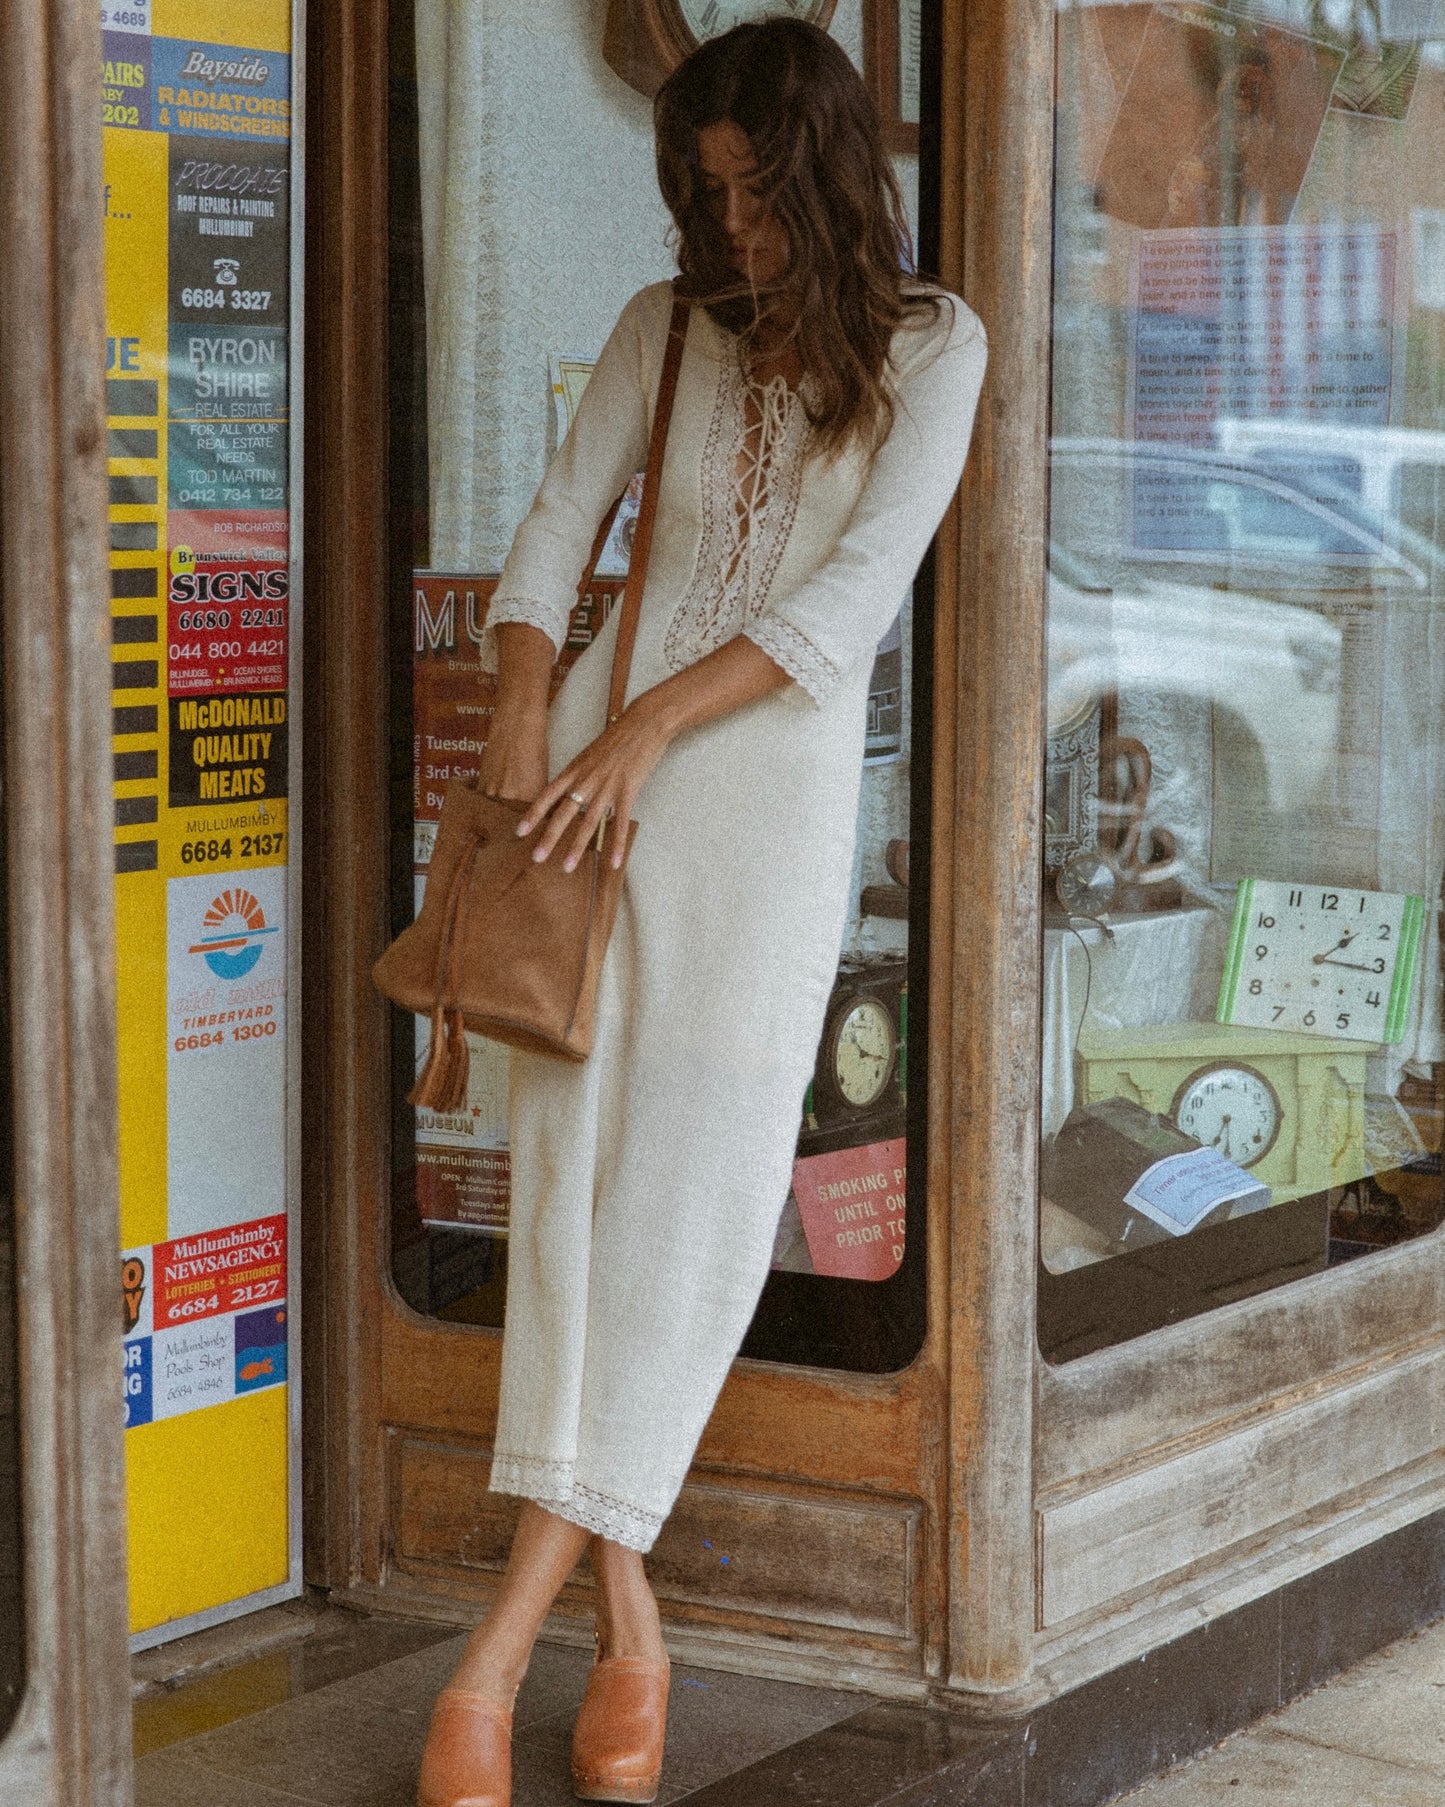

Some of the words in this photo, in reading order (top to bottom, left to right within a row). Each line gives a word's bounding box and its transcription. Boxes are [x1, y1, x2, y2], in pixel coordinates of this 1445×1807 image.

[113, 10, 146, 27] 4689
[183, 51, 269, 81] Bayside
[157, 86, 290, 118] RADIATORS
[159, 107, 170, 126] &
[175, 161, 288, 194] PROCOATE
[177, 195, 197, 212] ROOF
[198, 196, 231, 214] REPAIRS
[232, 198, 239, 215] &
[240, 199, 275, 217] PAINTING
[181, 288, 225, 310] 6684
[231, 290, 272, 310] 3327
[188, 337, 276, 365] BYRON
[195, 372, 271, 398] SHIRE
[195, 402, 228, 418] REAL
[230, 402, 273, 418] ESTATE
[190, 424, 215, 436] FOR
[220, 424, 243, 435] ALL
[247, 423, 280, 435] YOUR
[197, 438, 229, 450] REAL
[232, 437, 274, 449] ESTATE
[216, 452, 256, 463] NEEDS
[187, 470, 218, 484] TOD
[222, 469, 276, 483] MARTIN
[179, 489, 216, 502] 0412
[223, 488, 252, 501] 734
[258, 487, 284, 500] 122
[214, 523, 233, 532] BOB
[235, 521, 289, 533] RICHARDSO
[178, 550, 247, 564] Brunswick
[251, 546, 288, 565] Valley
[169, 570, 289, 604] SIGNS
[178, 610, 231, 631] 6680
[240, 608, 285, 628] 2241
[169, 643, 202, 660] 044
[208, 641, 242, 658] 800
[247, 639, 284, 656] 4421
[223, 676, 260, 686] BRUNSWICK
[261, 674, 283, 684] HEADS
[233, 666, 256, 676] OCEAN
[257, 665, 282, 675] SHORES
[179, 697, 287, 731] McDONALD
[193, 732, 273, 768] QUALITY
[426, 764, 449, 779] 3rd
[200, 767, 266, 800] MEATS
[427, 792, 445, 810] By
[186, 813, 279, 834] MULLUMBIMBY
[181, 838, 232, 865] 6684
[240, 832, 284, 858] 2137
[1289, 890, 1303, 907] 11
[1321, 893, 1339, 910] 12
[1359, 897, 1366, 913] 1
[1257, 912, 1275, 929] 10
[1377, 924, 1391, 941] 2
[1255, 945, 1268, 961] 9
[1371, 958, 1386, 974] 3
[1248, 978, 1263, 996] 8
[1364, 991, 1381, 1008] 4
[182, 1004, 274, 1030] TIMBERYARD
[1271, 1006, 1286, 1022] 7
[1302, 1009, 1317, 1027] 6
[1335, 1012, 1351, 1030] 5
[174, 1030, 224, 1053] 6684
[232, 1021, 277, 1042] 1300
[1191, 1096, 1203, 1109] 10
[415, 1114, 474, 1136] MUSEUM
[1186, 1115, 1194, 1127] 9
[441, 1173, 462, 1182] OPEN:
[455, 1183, 467, 1191] 3rd
[468, 1184, 498, 1195] Saturday
[817, 1173, 888, 1202] SMOKING
[834, 1200, 879, 1224] UNTIL
[172, 1225, 275, 1261] Mullumbimby
[835, 1223, 884, 1248] PRIOR
[164, 1239, 283, 1284] NEWSAGENCY
[165, 1279, 216, 1300] LOTTERIES
[228, 1263, 282, 1286] STATIONERY
[167, 1293, 220, 1320] 6684
[230, 1279, 279, 1306] 2127
[164, 1331, 227, 1360] Mullumbimby
[166, 1359, 194, 1379] Pools
[198, 1353, 226, 1370] Shop
